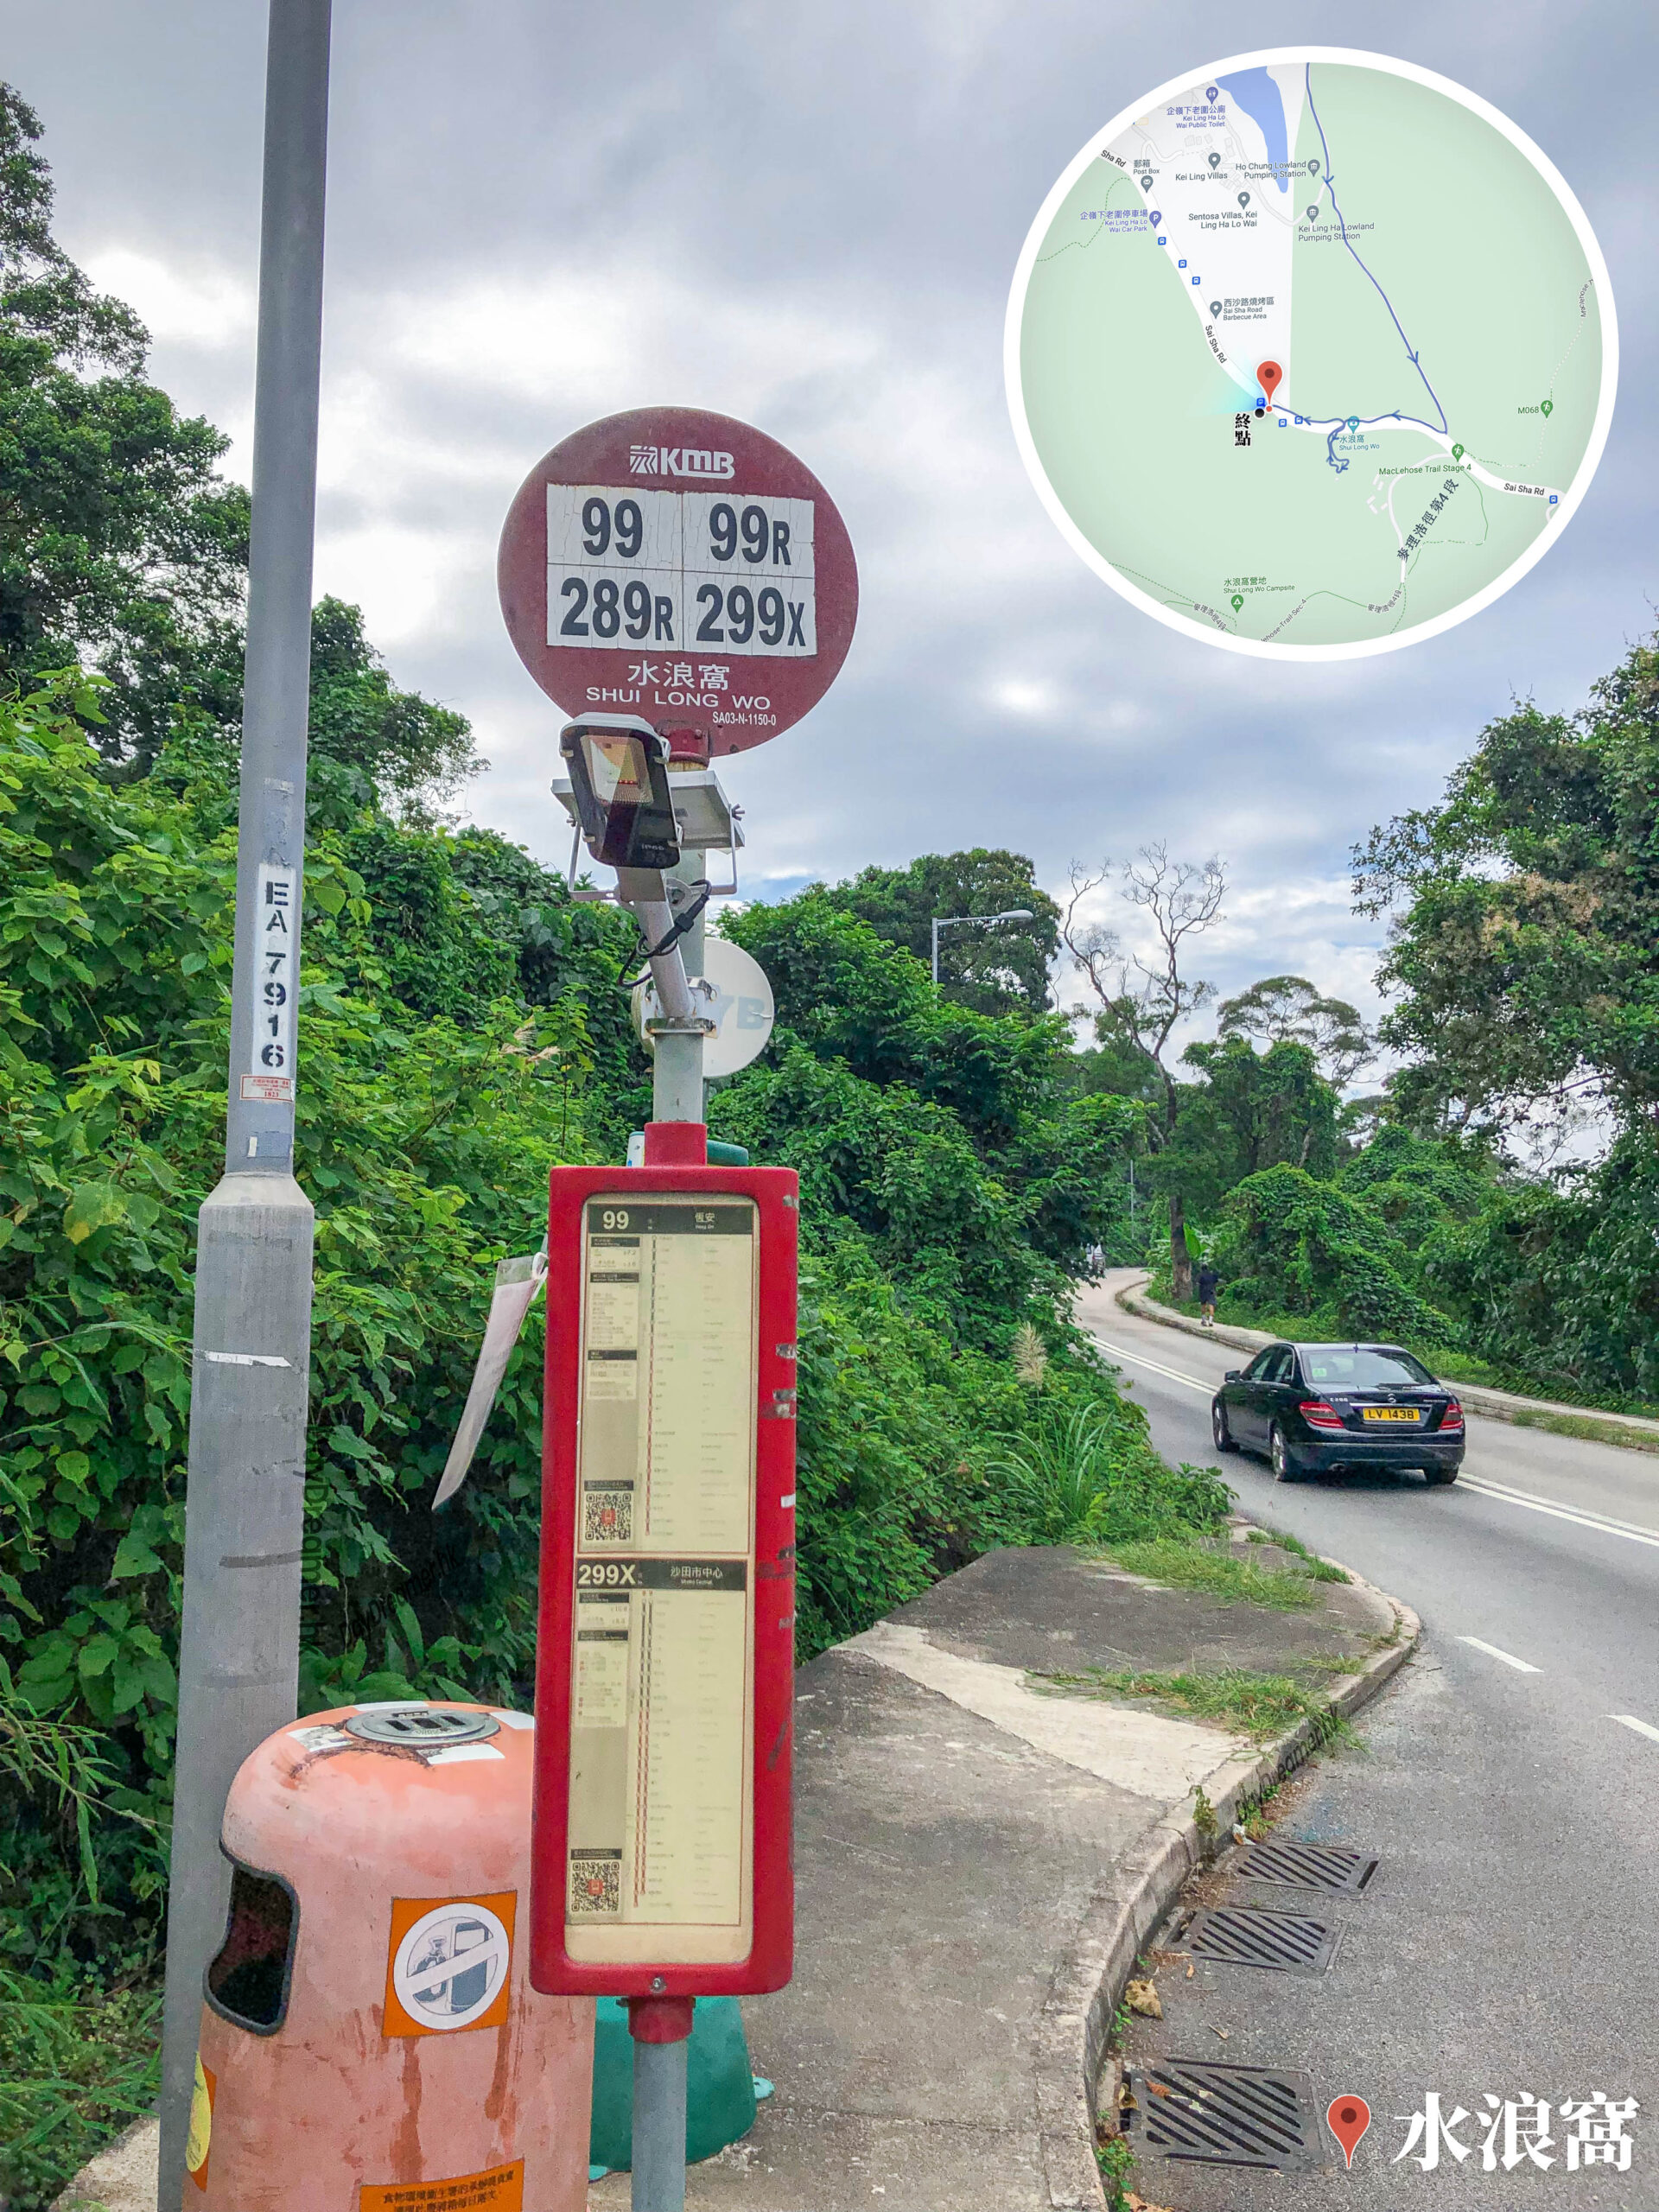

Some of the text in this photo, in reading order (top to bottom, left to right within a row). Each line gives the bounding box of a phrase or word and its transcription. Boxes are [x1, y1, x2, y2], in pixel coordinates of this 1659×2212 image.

[660, 448, 735, 480] KMB
[582, 497, 643, 558] 99
[709, 502, 791, 566] 99R
[560, 576, 675, 642] 289R
[696, 583, 806, 647] 299X
[627, 660, 730, 691] 水浪窩
[586, 686, 771, 710] SHUI LONG WO
[712, 711, 777, 727] SA03-N-1150-0
[265, 881, 289, 934] EA
[261, 952, 287, 1068] 7916
[603, 1211, 629, 1230] 99
[1389, 1410, 1414, 1419] 1438
[578, 1564, 636, 1585] 299X
[671, 1566, 723, 1580] 沙田市中心
